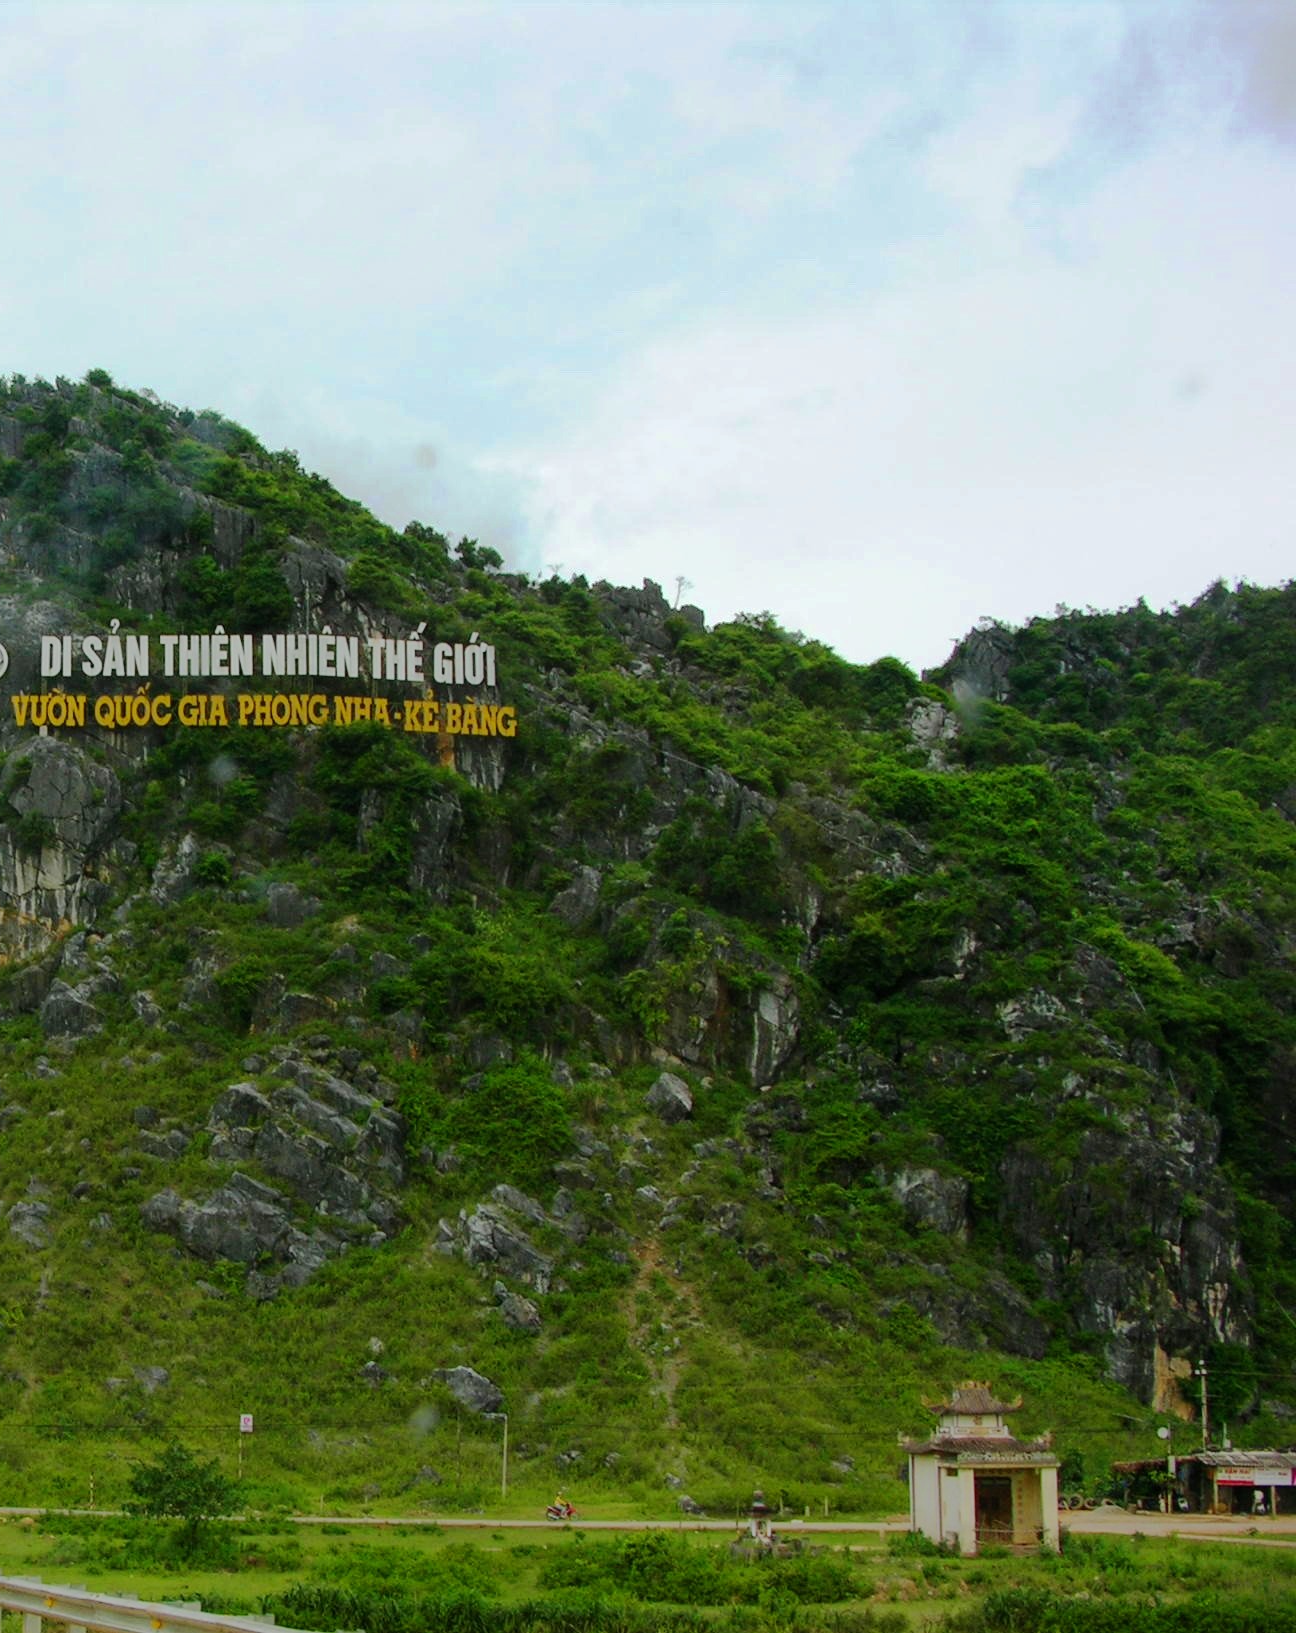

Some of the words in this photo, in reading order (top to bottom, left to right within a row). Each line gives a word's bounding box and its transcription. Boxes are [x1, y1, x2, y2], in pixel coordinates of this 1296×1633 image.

[41, 635, 71, 677] DI
[82, 618, 149, 677] SẢN
[159, 625, 253, 677] THIÊN
[262, 625, 359, 678] NHIÊN
[368, 621, 426, 681] THẾ
[434, 631, 496, 686] GIỚI
[94, 682, 171, 728] QUỐC
[178, 695, 228, 727] GIA
[238, 694, 329, 727] PHONG
[446, 695, 517, 737] BÀNG
